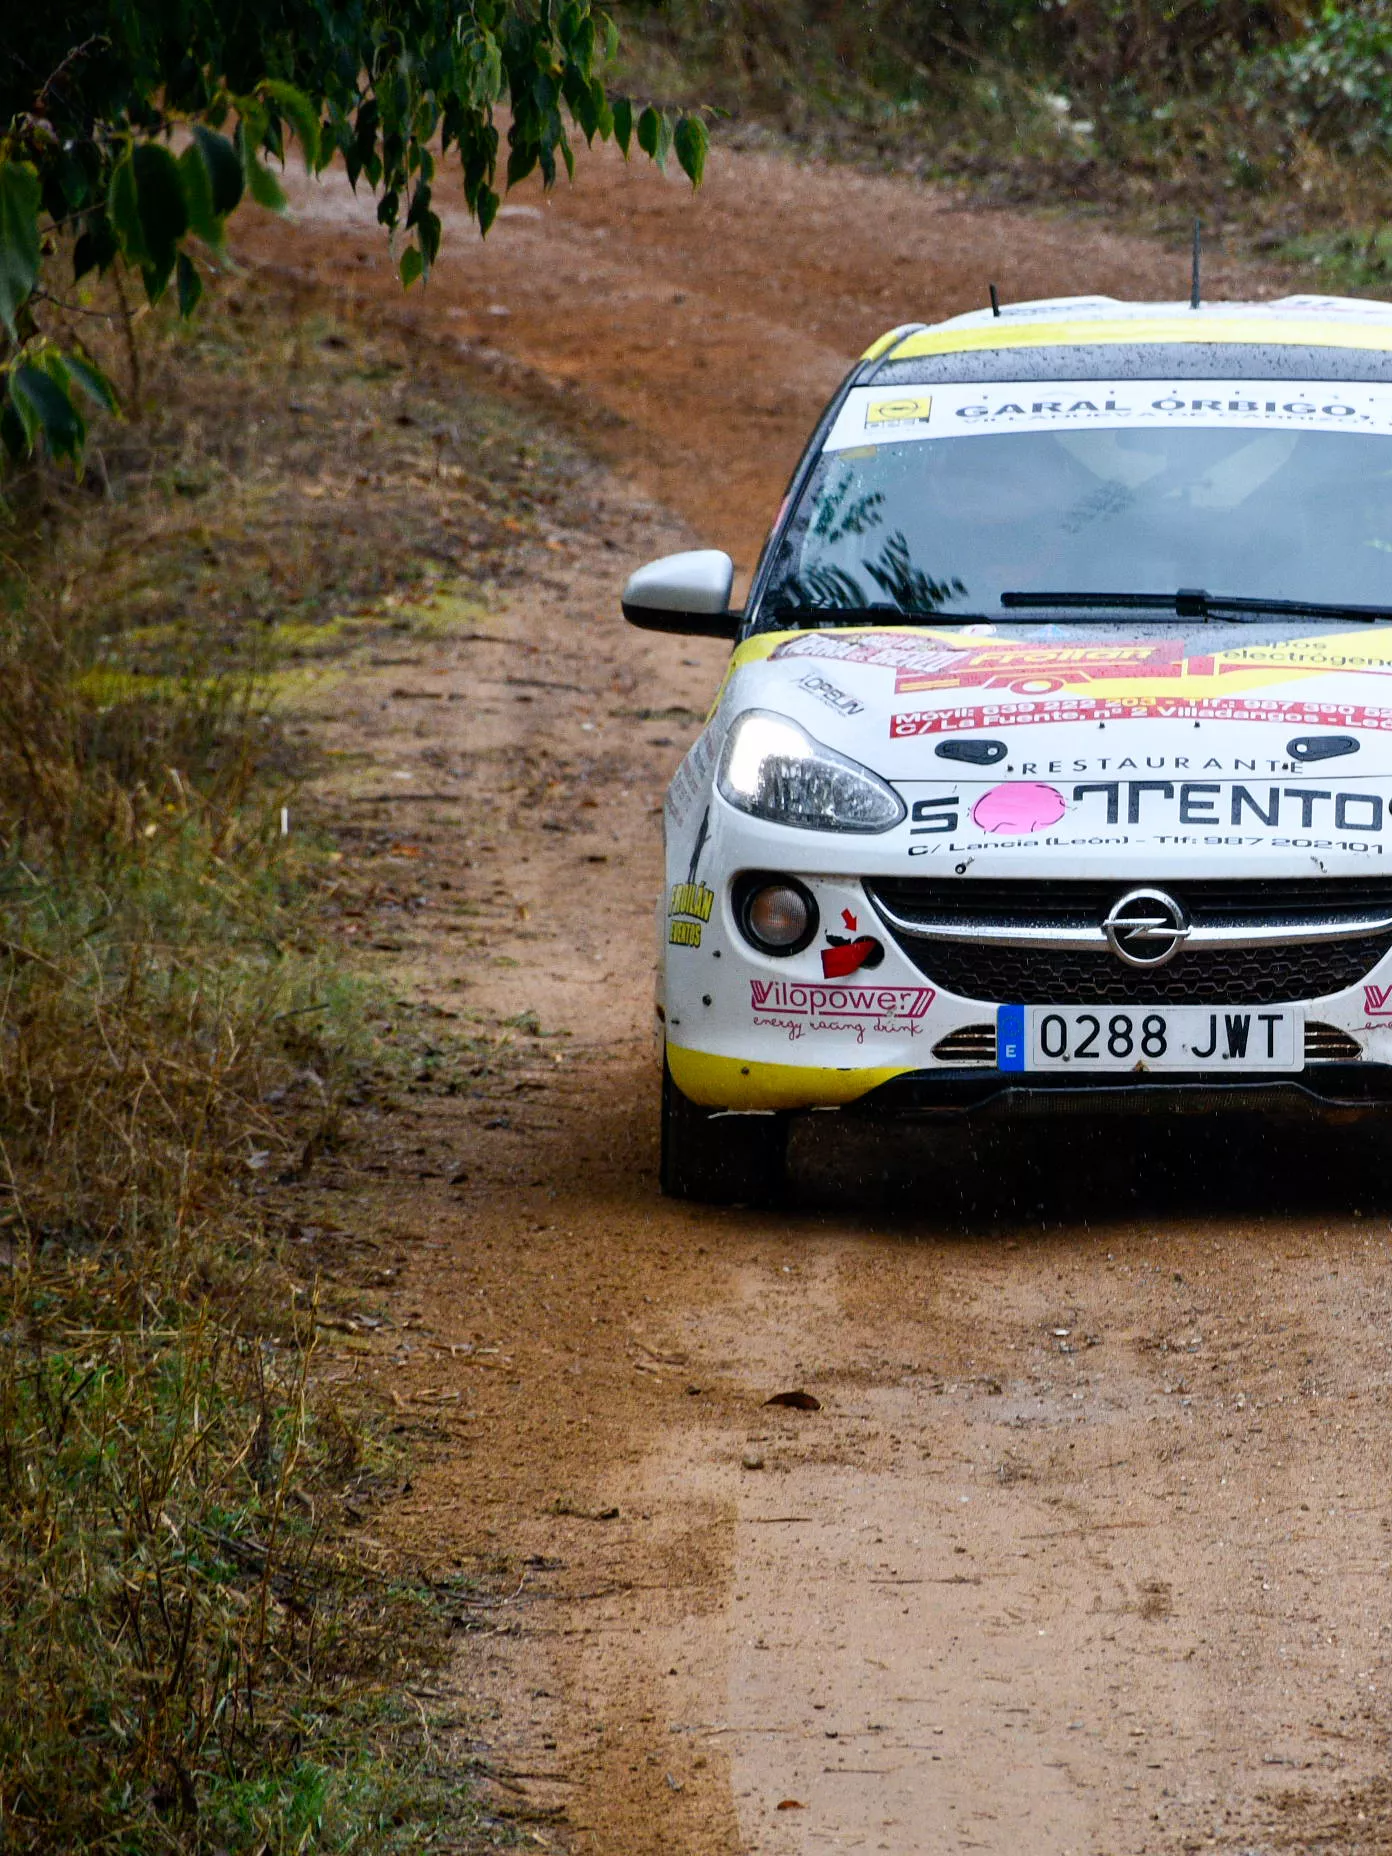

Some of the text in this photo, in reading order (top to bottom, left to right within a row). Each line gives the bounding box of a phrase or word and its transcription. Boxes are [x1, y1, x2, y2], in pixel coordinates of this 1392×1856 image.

[955, 400, 1131, 416] GARAL
[941, 718, 975, 730] La
[1131, 707, 1148, 717] 2
[1158, 706, 1320, 723] Villadangos
[1022, 756, 1304, 775] RESTAURANTE
[908, 843, 942, 856] C/
[949, 839, 1039, 852] Lancia
[1046, 836, 1129, 846] (León)
[1204, 837, 1264, 846] 987
[1271, 837, 1383, 854] 202101
[668, 881, 715, 923] FROILÁN
[669, 919, 702, 948] EVENTOS
[750, 980, 915, 1015] Vilopower
[753, 1016, 924, 1044] energy racing drink
[1041, 1014, 1284, 1059] 0288 JWT
[1005, 1044, 1017, 1058] E
